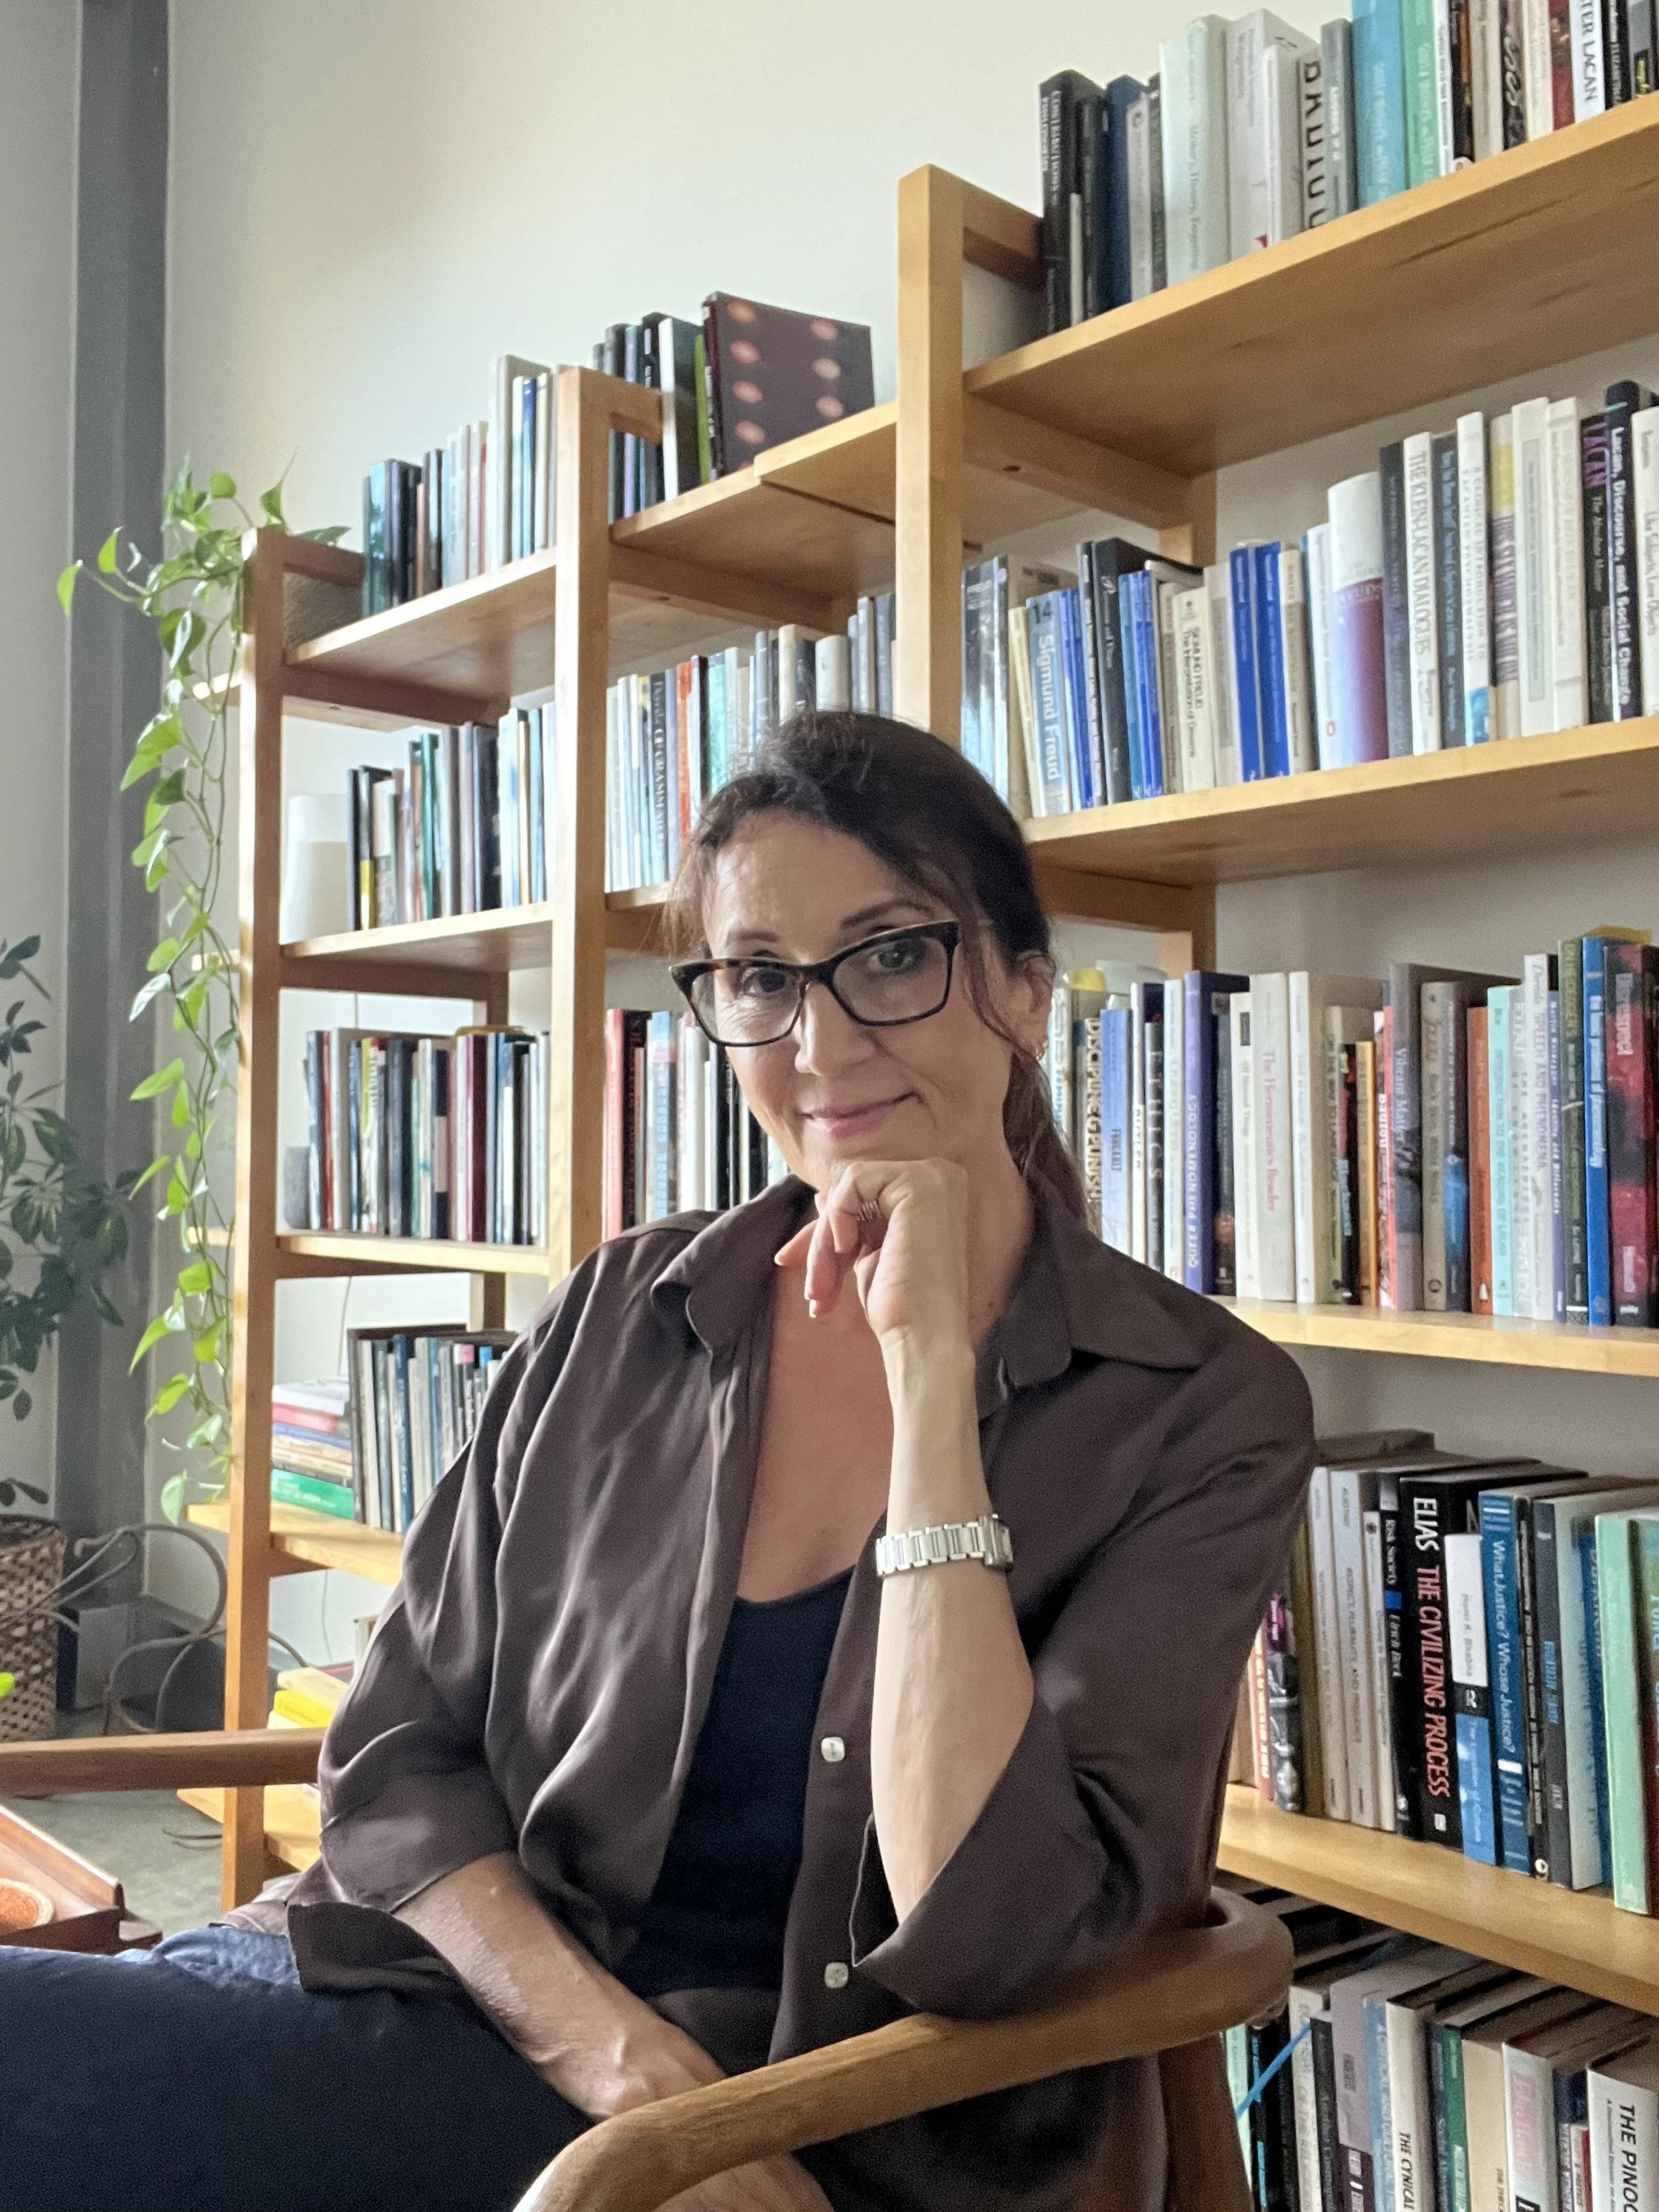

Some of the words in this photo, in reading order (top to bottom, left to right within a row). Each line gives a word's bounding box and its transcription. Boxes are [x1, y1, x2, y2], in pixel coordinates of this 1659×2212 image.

[1580, 0, 1595, 37] TER
[1582, 41, 1598, 102] LACAN
[1410, 452, 1430, 479] THE
[1611, 428, 1625, 479] Lacan,
[1612, 481, 1627, 562] Discourse,
[1615, 565, 1630, 593] and
[1031, 603, 1052, 625] 14
[1412, 577, 1431, 655] DIALOGUES
[1616, 596, 1631, 644] Social
[1037, 634, 1057, 719] Sigmund
[1617, 647, 1632, 705] Change
[1045, 724, 1059, 780] Freud
[1395, 1047, 1408, 1095] Vibrant
[1148, 1050, 1164, 1179] ETHICS
[1393, 1098, 1408, 1143] Matter
[1186, 1093, 1198, 1218] PHENOMENOLOGY
[1187, 1225, 1198, 1267] QUEER
[1385, 1519, 1398, 1542] Risk
[1413, 1497, 1440, 1552] ELIAS
[1385, 1545, 1398, 1585] Society
[1416, 1564, 1442, 1601] THE
[1493, 1539, 1506, 1579] What
[1494, 1579, 1510, 1639] Justice?
[1419, 1606, 1446, 1708] CIVILIZING
[1498, 1642, 1511, 1693] Whose
[1500, 1694, 1516, 1753] Justice?
[1425, 1712, 1451, 1798] PROCESS
[1399, 2132, 1412, 2155] THE
[1620, 2105, 1637, 2145] THE
[1402, 2158, 1415, 2211] CYNICAL
